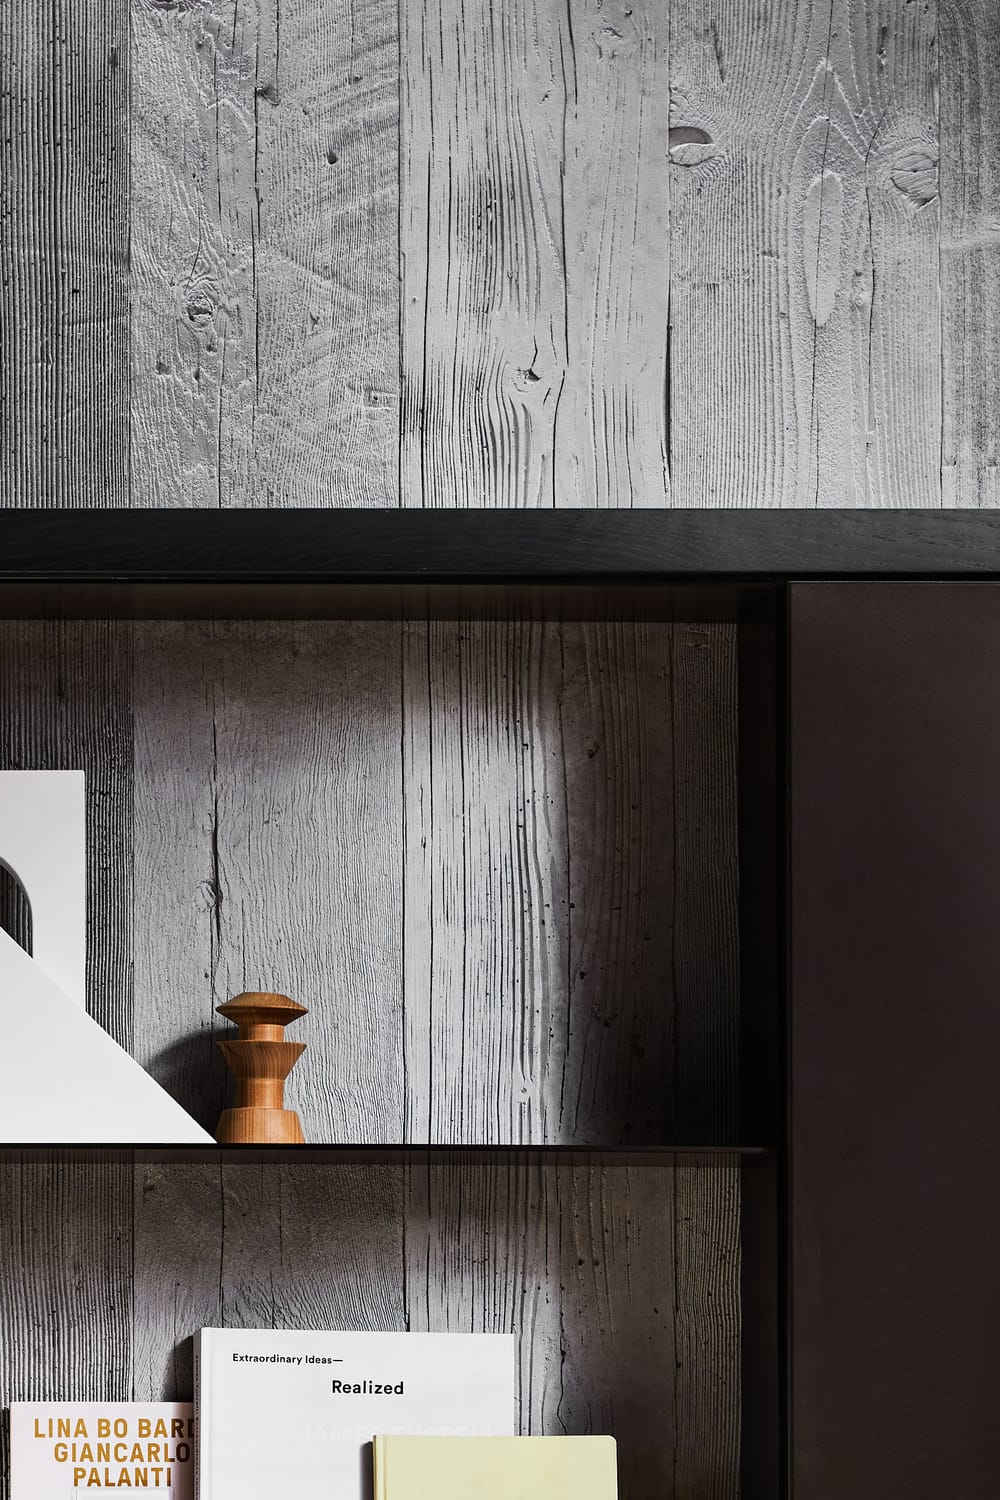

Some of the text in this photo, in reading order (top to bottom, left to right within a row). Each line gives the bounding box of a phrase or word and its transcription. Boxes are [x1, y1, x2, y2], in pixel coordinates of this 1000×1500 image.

[232, 1353, 303, 1366] Extraordinary
[332, 1379, 405, 1396] Realized
[34, 1417, 88, 1439] LINA
[97, 1417, 128, 1439] BO
[53, 1442, 191, 1463] GIANCARLO
[73, 1467, 172, 1488] PALANTI
